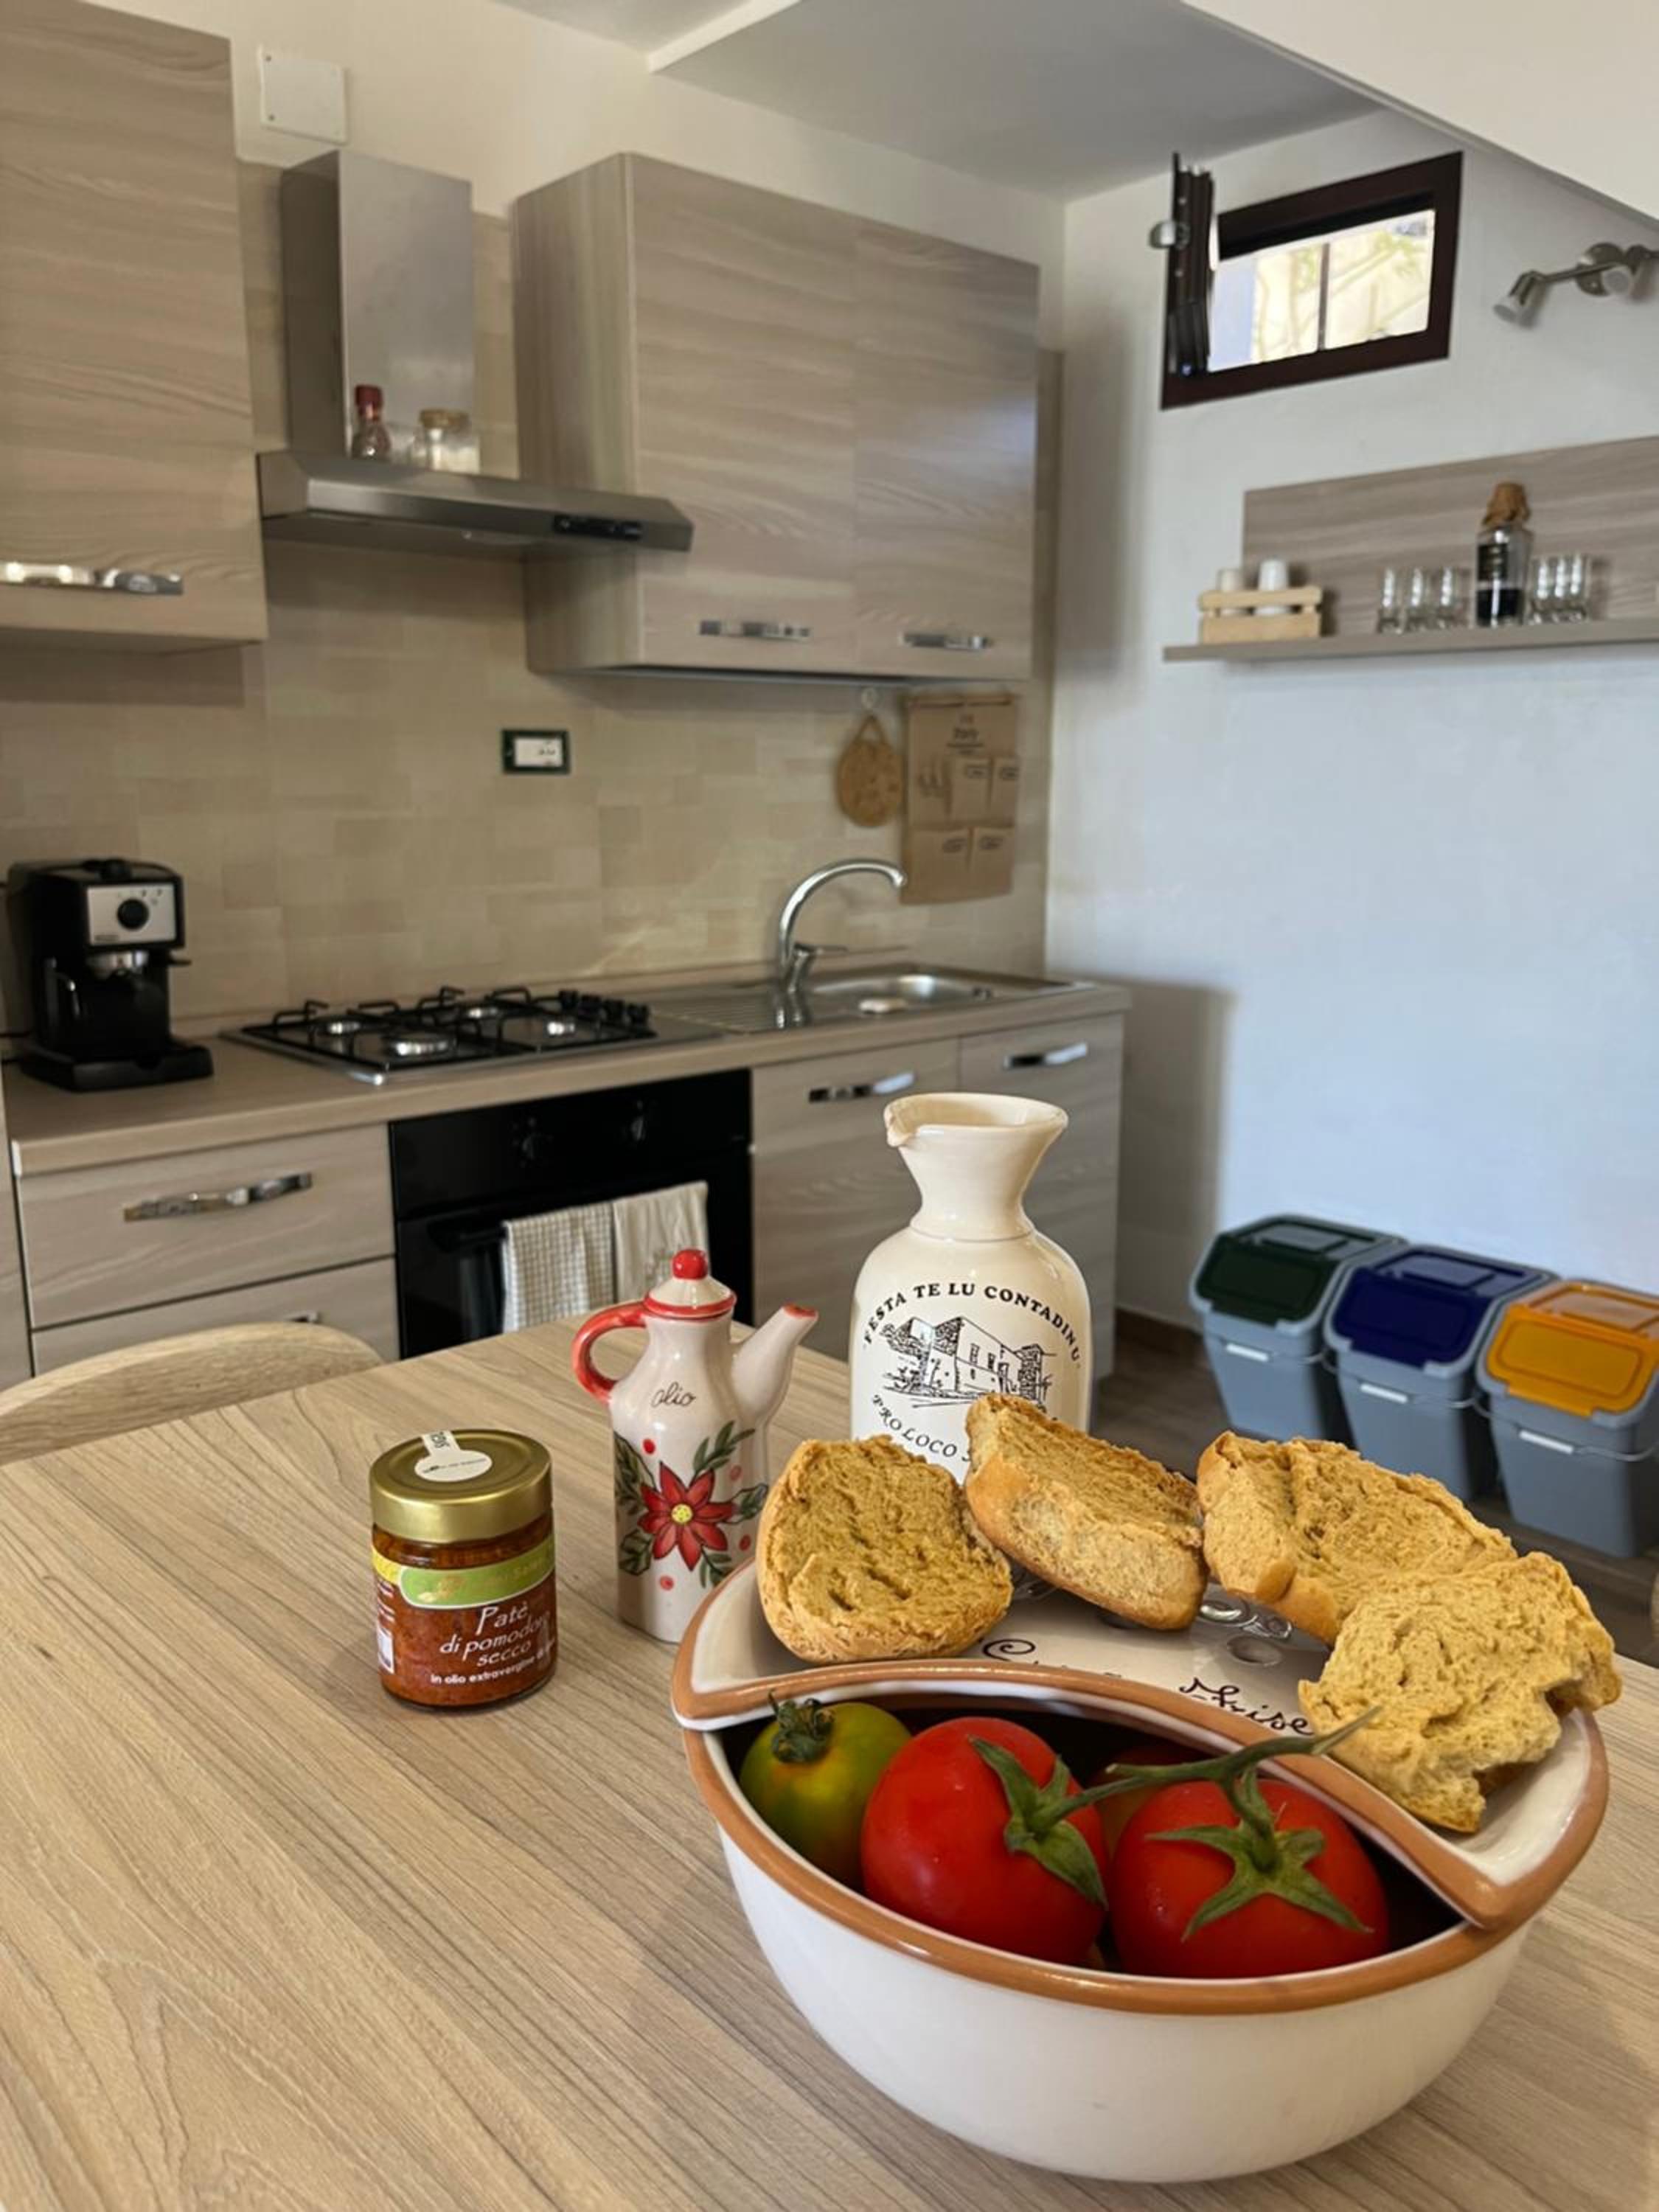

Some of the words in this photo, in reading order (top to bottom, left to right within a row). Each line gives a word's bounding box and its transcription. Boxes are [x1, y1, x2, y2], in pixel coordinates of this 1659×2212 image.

[863, 1291, 908, 1345] FESTA
[913, 1282, 942, 1299] TE
[947, 1282, 976, 1296] LU
[984, 1284, 1081, 1363] CONTADINU
[650, 1381, 696, 1408] olio
[872, 1394, 902, 1431] PRO
[901, 1427, 958, 1458] LOCO
[439, 1633, 462, 1653] di
[476, 1640, 532, 1667] secco
